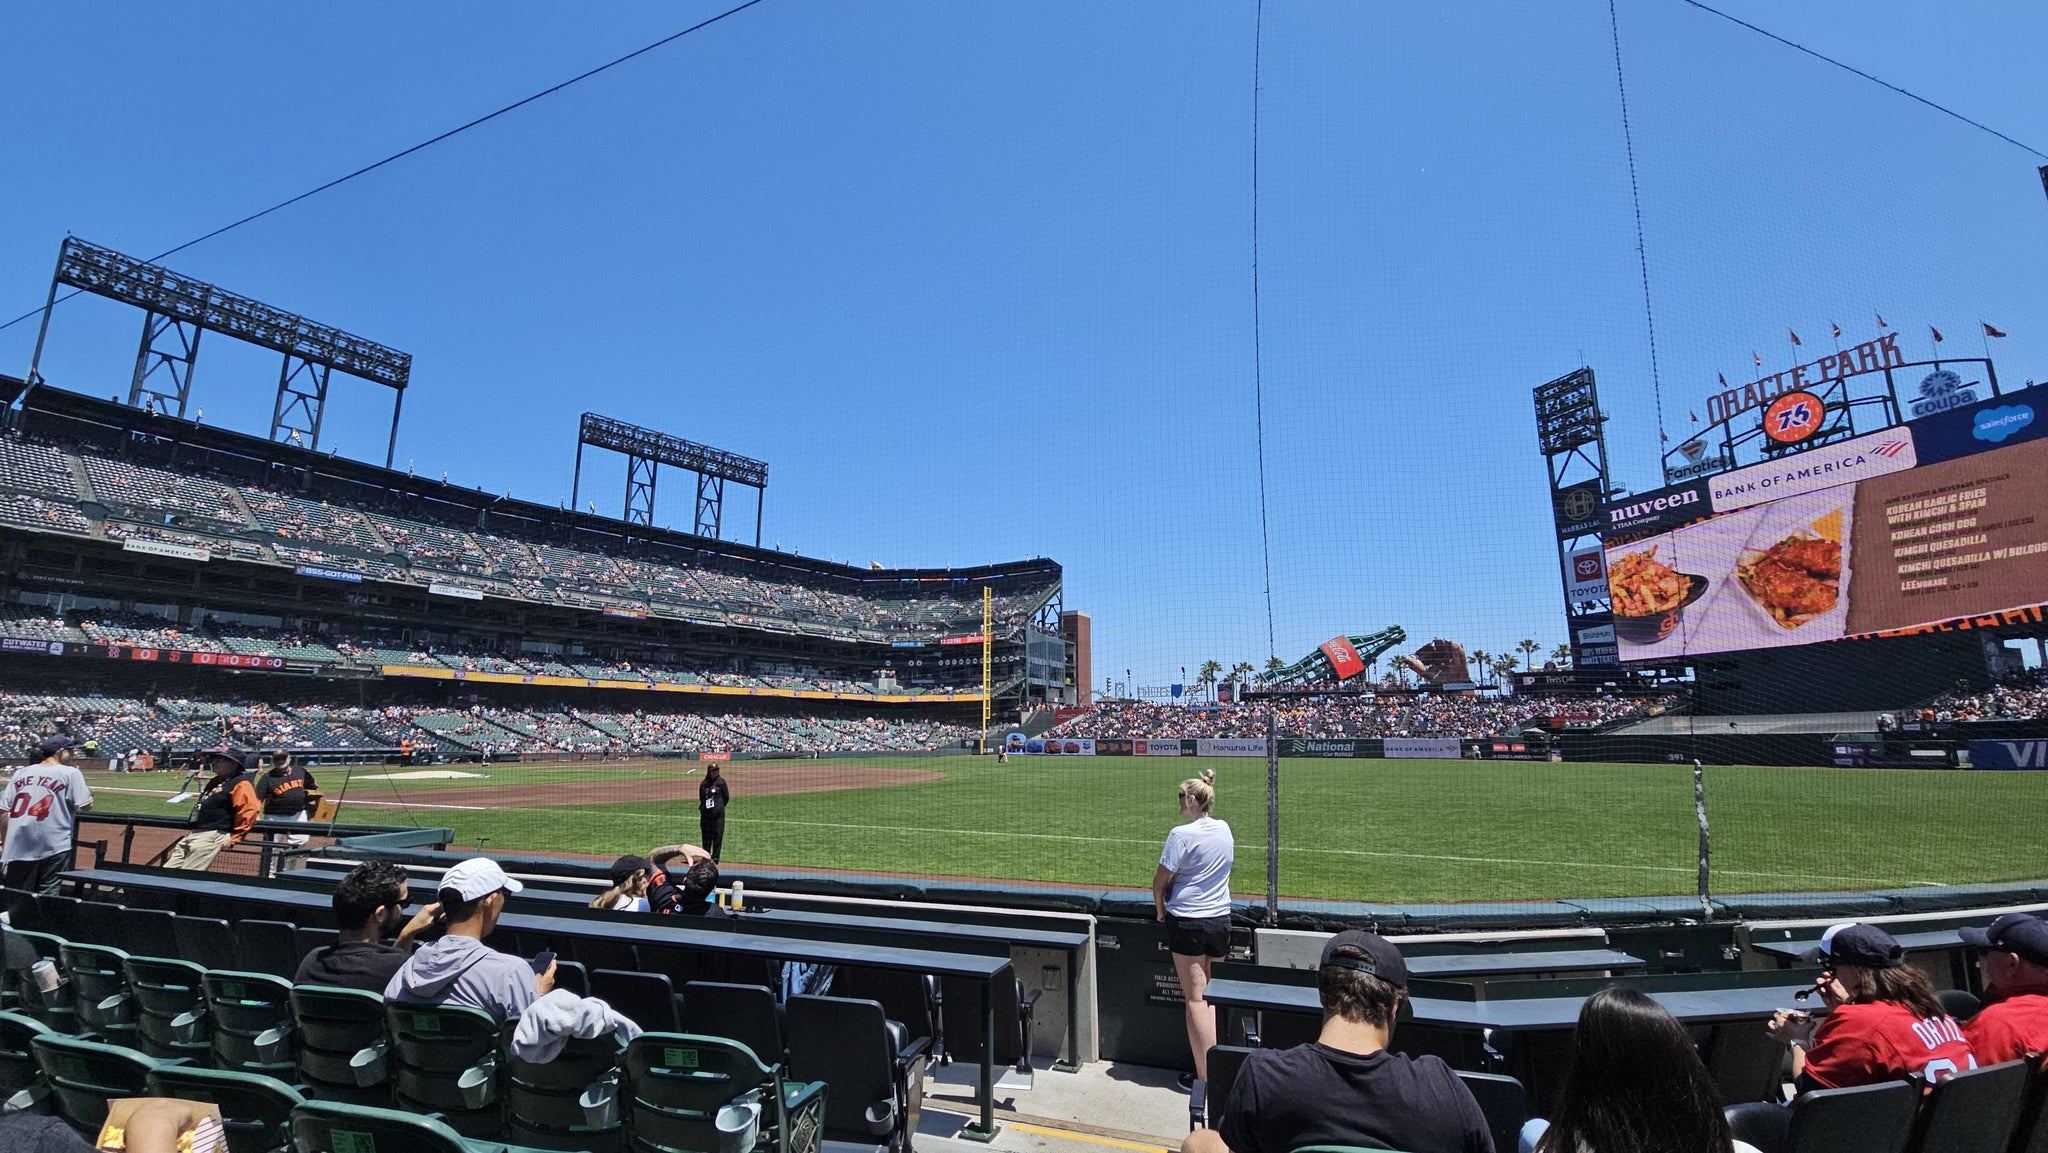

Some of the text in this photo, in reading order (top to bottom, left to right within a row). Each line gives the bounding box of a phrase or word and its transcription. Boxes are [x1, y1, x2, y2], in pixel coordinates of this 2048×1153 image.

[1707, 332, 1906, 426] ORACLE PARK
[1914, 390, 1975, 416] coupa
[1776, 402, 1812, 434] 76
[1979, 412, 2030, 430] salesforce
[1666, 456, 1731, 480] Fanatics
[1715, 455, 1866, 500] BANK OF AMERICA
[1611, 489, 1700, 523] nuveen
[1886, 487, 1987, 516] KOREAN GARLIC FRIES
[1887, 511, 1911, 525] WITH
[1913, 504, 1949, 520] KIMCHI
[1958, 497, 1988, 512] SPAM
[1633, 514, 1660, 528] Company
[1890, 525, 1928, 542] KOREAN
[1928, 520, 1956, 535] CORN
[1957, 517, 1977, 530] DOG
[126, 543, 147, 551] BANK
[157, 548, 192, 558] AMERICA
[1893, 542, 1929, 558] KIMCHI
[1929, 534, 1988, 552] QUESADILLA
[1897, 559, 1932, 574] KIMCHI
[1933, 551, 1992, 569] QUESADILLA
[1571, 586, 1610, 598] TOYOTA
[2, 638, 49, 648] CUTWATER
[1247, 743, 1264, 751] Life
[1306, 740, 1356, 752] National
[37, 775, 66, 795] YEAR
[10, 792, 55, 822] 04
